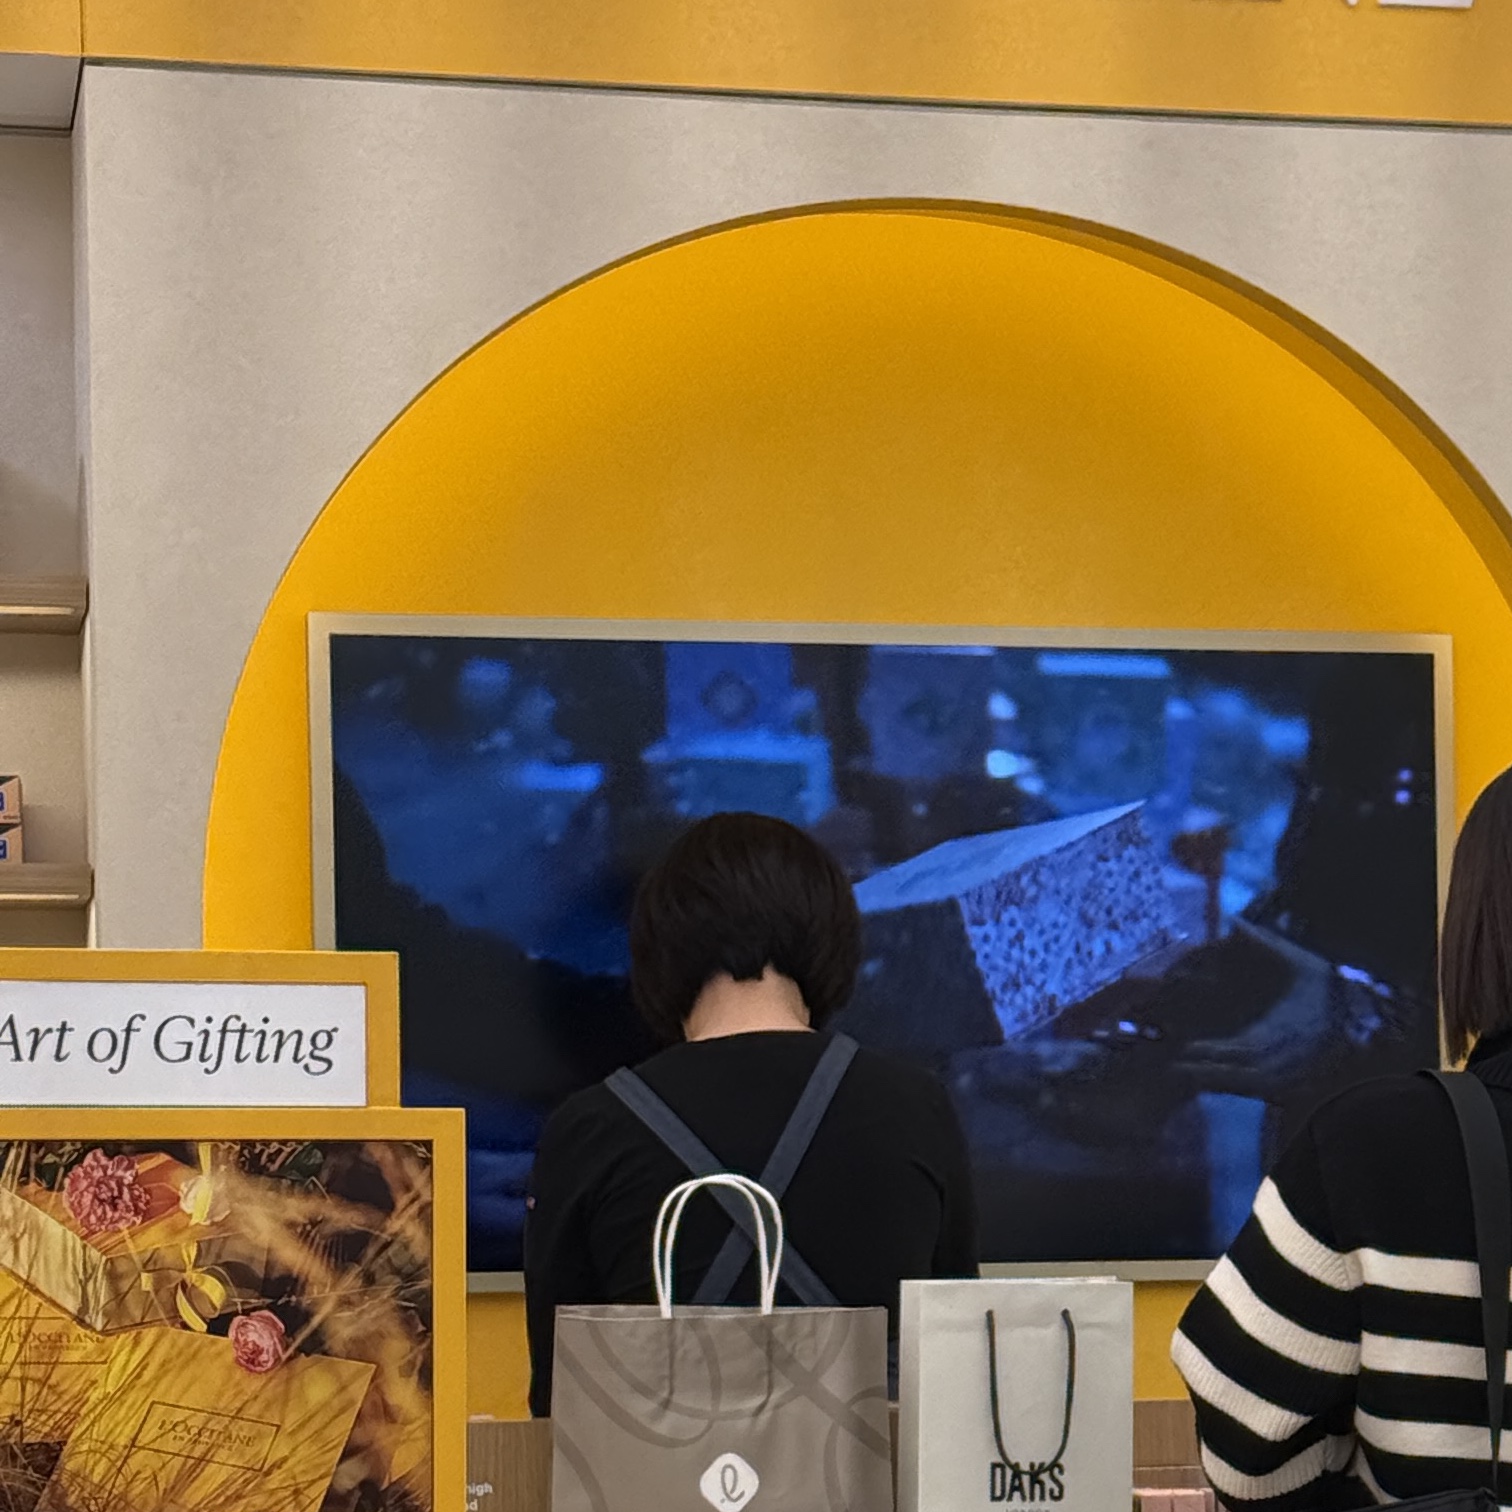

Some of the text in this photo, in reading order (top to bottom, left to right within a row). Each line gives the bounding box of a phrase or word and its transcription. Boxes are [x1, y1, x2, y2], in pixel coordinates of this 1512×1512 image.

[0, 1013, 340, 1077] Art of Gifting
[989, 1461, 1065, 1503] DAKS
